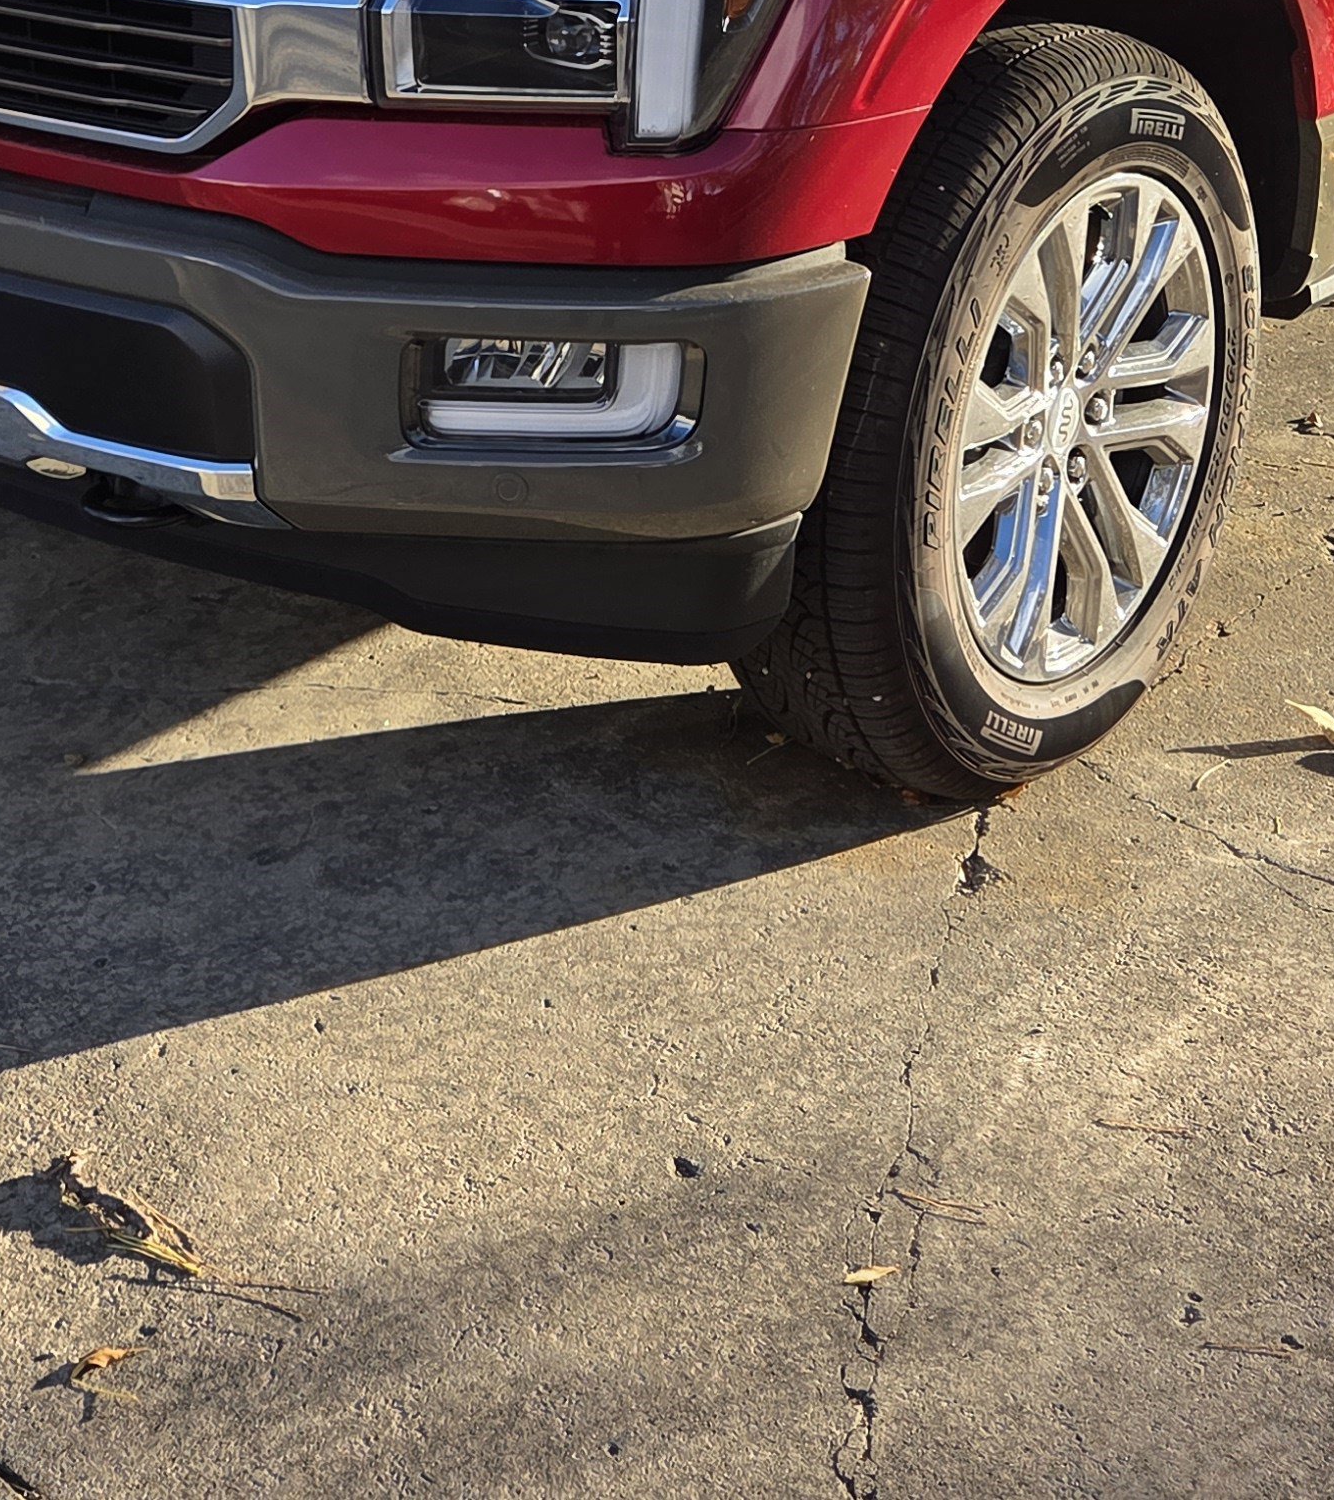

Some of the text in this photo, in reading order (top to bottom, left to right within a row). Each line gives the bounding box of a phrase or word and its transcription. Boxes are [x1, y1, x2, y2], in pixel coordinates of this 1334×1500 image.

[1129, 107, 1187, 141] PIRELLI
[923, 297, 984, 551] PIRELLI
[980, 710, 1044, 757] PIRELLI
